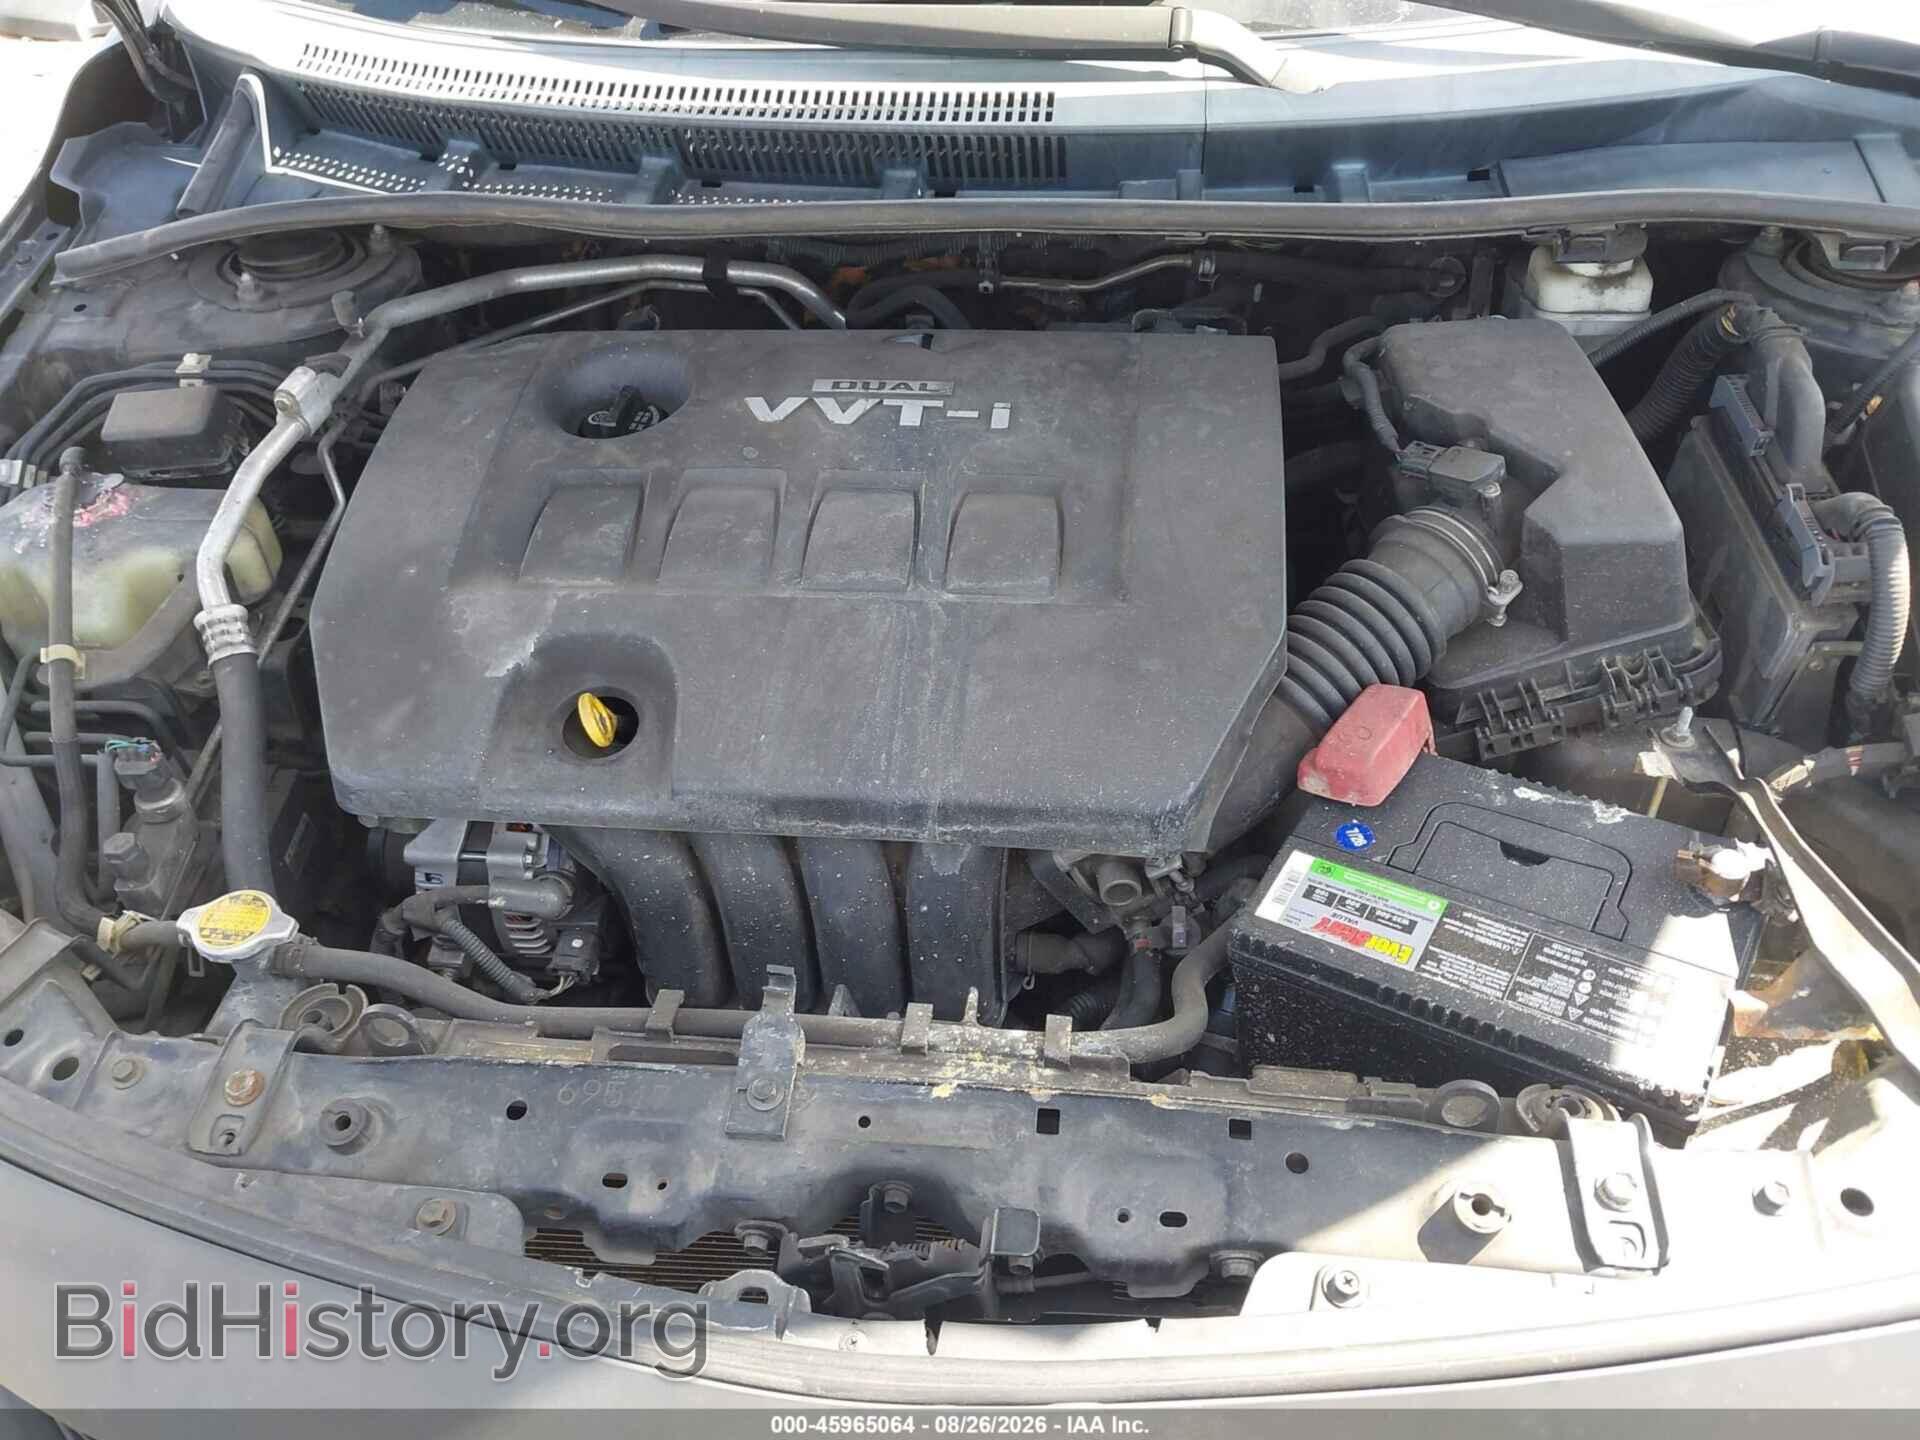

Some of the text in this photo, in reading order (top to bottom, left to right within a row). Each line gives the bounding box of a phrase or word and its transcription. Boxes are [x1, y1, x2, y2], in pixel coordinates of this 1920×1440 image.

[831, 380, 941, 392] DUAL
[744, 396, 1012, 429] VVT-i
[1331, 911, 1360, 926] VALUE
[1312, 915, 1414, 965] EverStart
